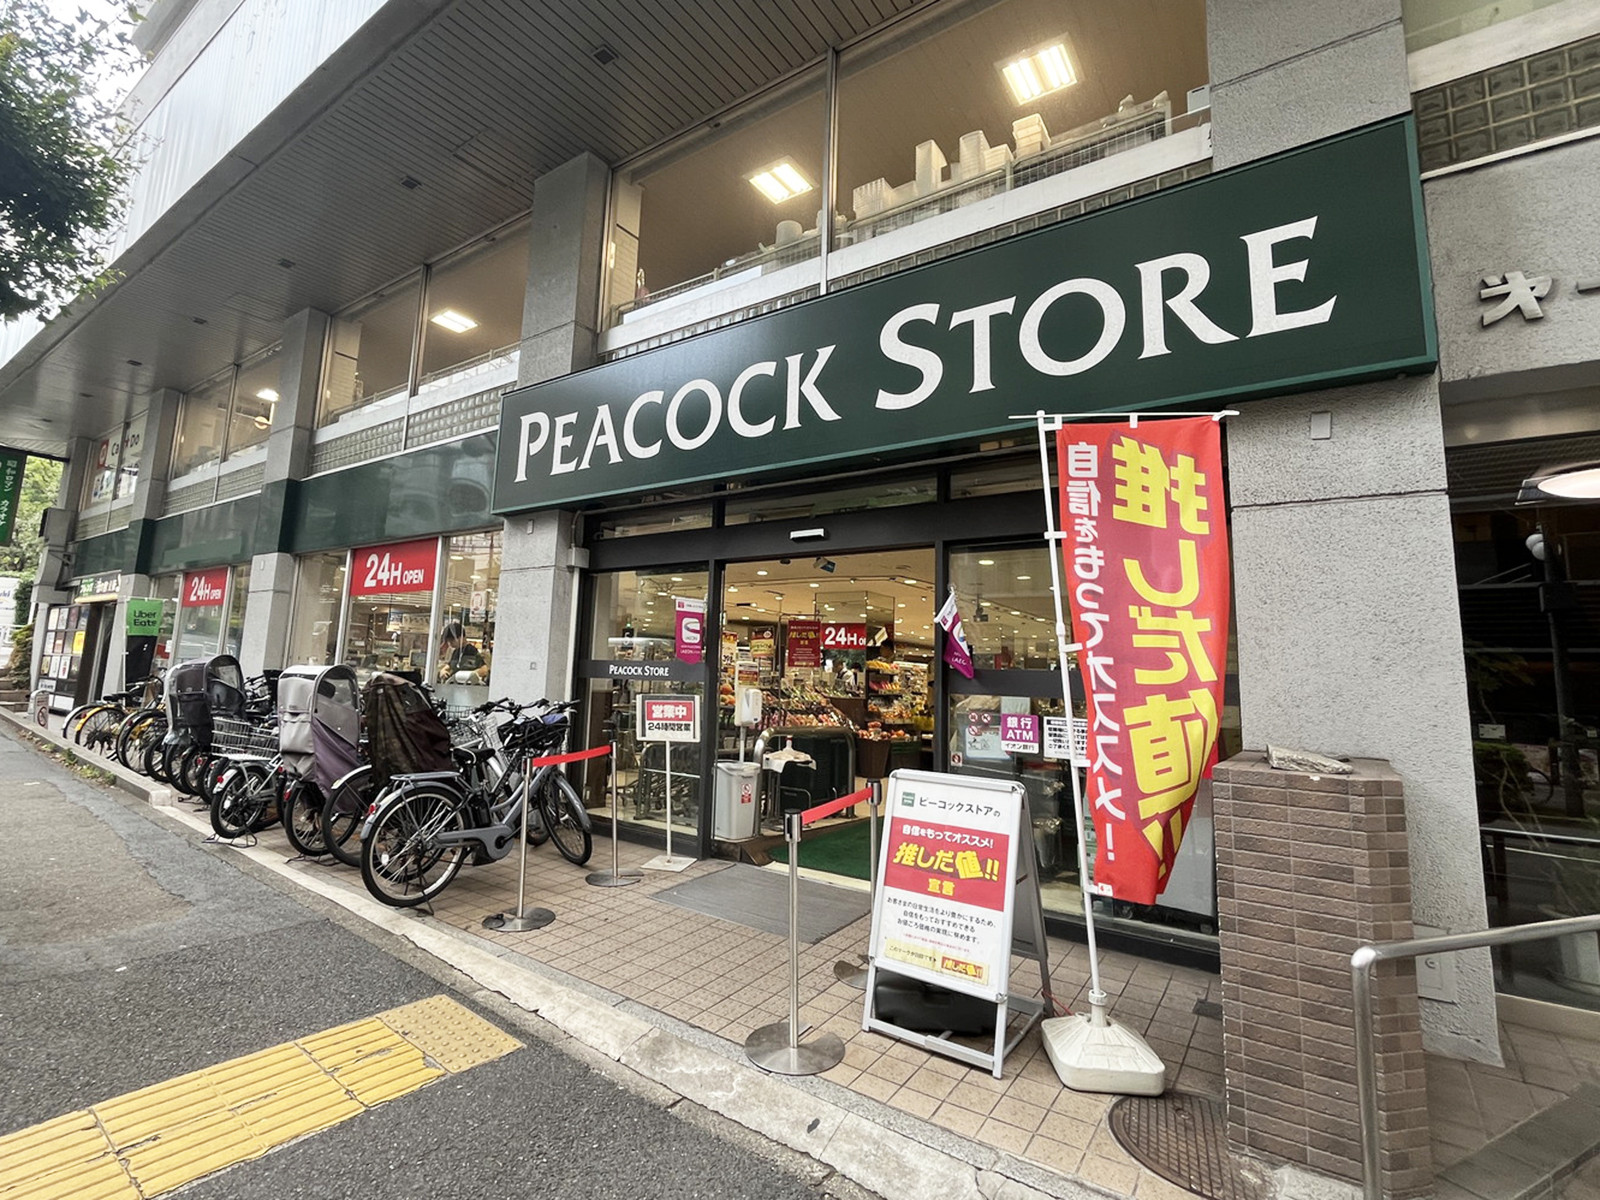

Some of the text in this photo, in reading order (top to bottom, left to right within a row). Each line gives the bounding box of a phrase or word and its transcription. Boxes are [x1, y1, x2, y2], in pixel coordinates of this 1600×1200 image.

[514, 216, 1337, 483] PEACOCK STORE
[363, 553, 424, 588] 24H OPEN
[190, 576, 210, 602] 24H
[133, 610, 156, 619] Uber
[133, 618, 157, 627] Eats
[824, 627, 857, 646] 24H
[609, 664, 669, 677] PEACOCK STORE
[651, 705, 687, 719] 営業中
[647, 722, 691, 732] 24時間営業
[1006, 716, 1032, 730] 銀行
[1006, 729, 1034, 741] ATM
[1005, 742, 1035, 751] イオン銀行
[919, 796, 1001, 818] ピーコックストアの
[902, 824, 994, 849] 自信をもってオススメ!
[893, 842, 999, 881] 推しだ値!!
[927, 878, 955, 896] 宣言
